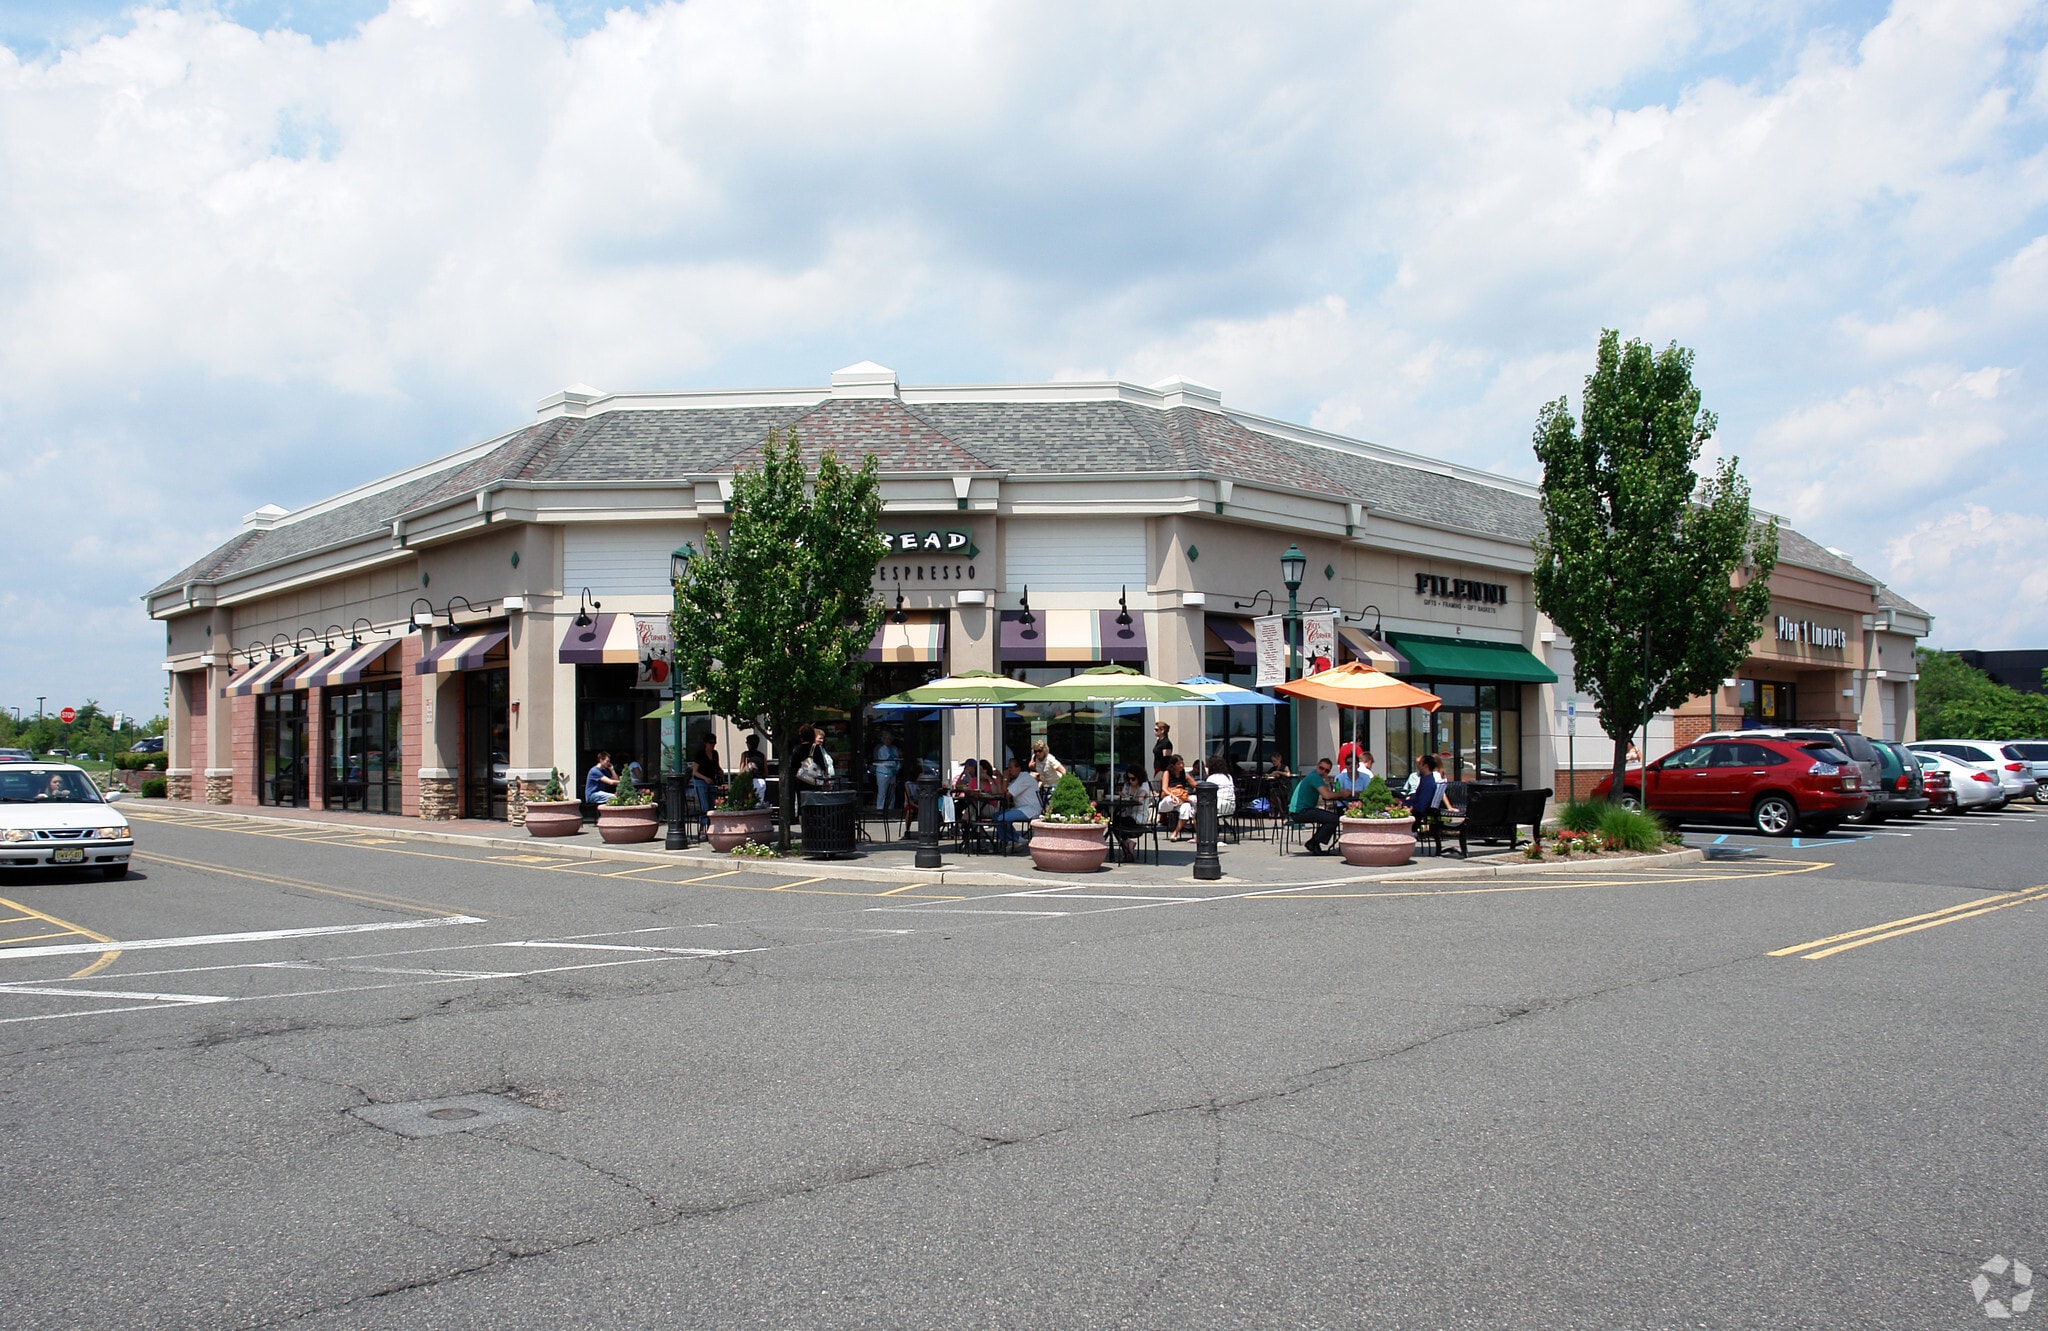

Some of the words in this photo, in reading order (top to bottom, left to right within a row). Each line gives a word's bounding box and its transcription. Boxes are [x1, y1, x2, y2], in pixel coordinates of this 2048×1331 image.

[877, 531, 967, 550] READ
[880, 565, 976, 581] ESPRESSO
[1415, 573, 1508, 605] FILENNI
[1442, 601, 1462, 609] FRAMING
[1467, 604, 1477, 612] GIFT
[1478, 605, 1496, 614] BASKETS
[1778, 615, 1799, 641] Pier
[61, 711, 75, 719] STOP
